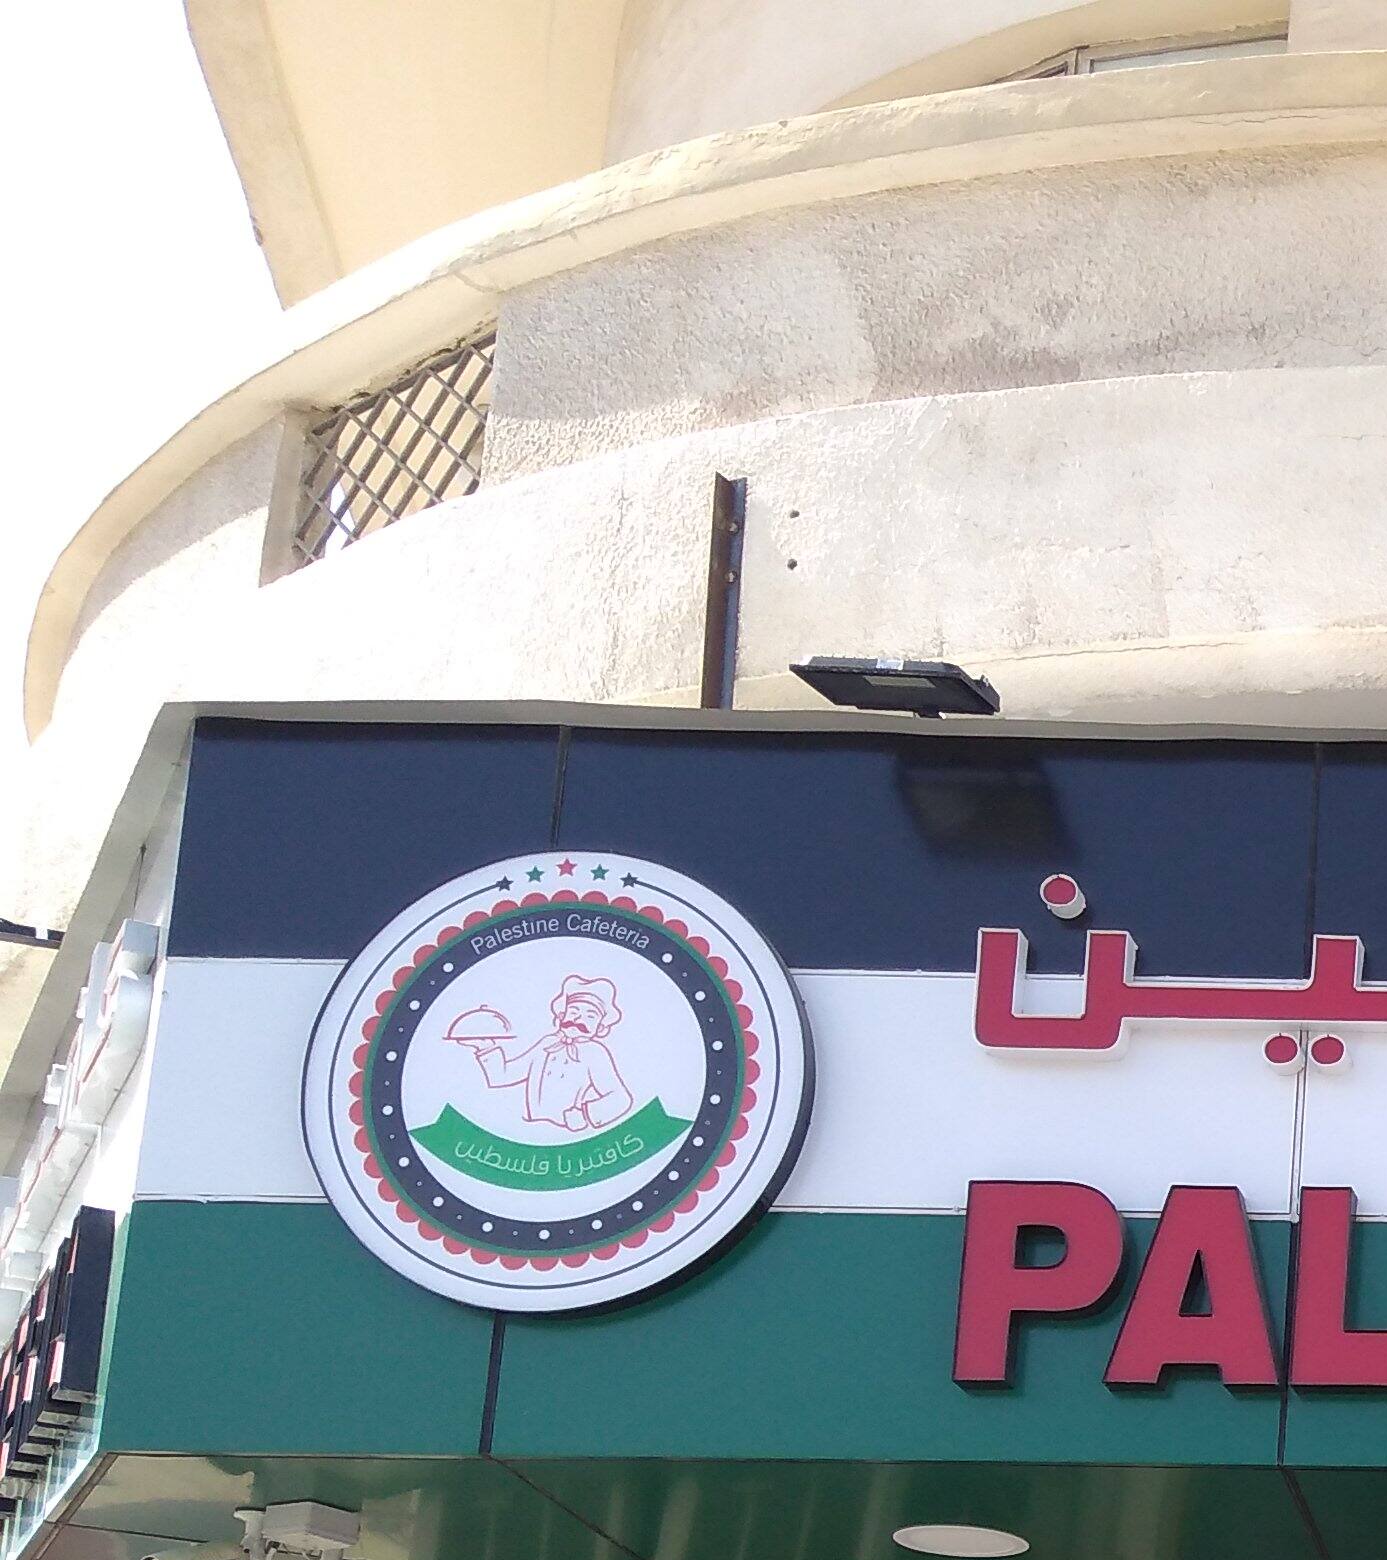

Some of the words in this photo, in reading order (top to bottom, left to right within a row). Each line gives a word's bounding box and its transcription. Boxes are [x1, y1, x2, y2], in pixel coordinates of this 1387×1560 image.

[470, 917, 560, 955] Palestine
[566, 913, 651, 950] Cafeteria
[454, 1140, 550, 1176] فلسطين
[557, 1133, 645, 1178] كافتيريا
